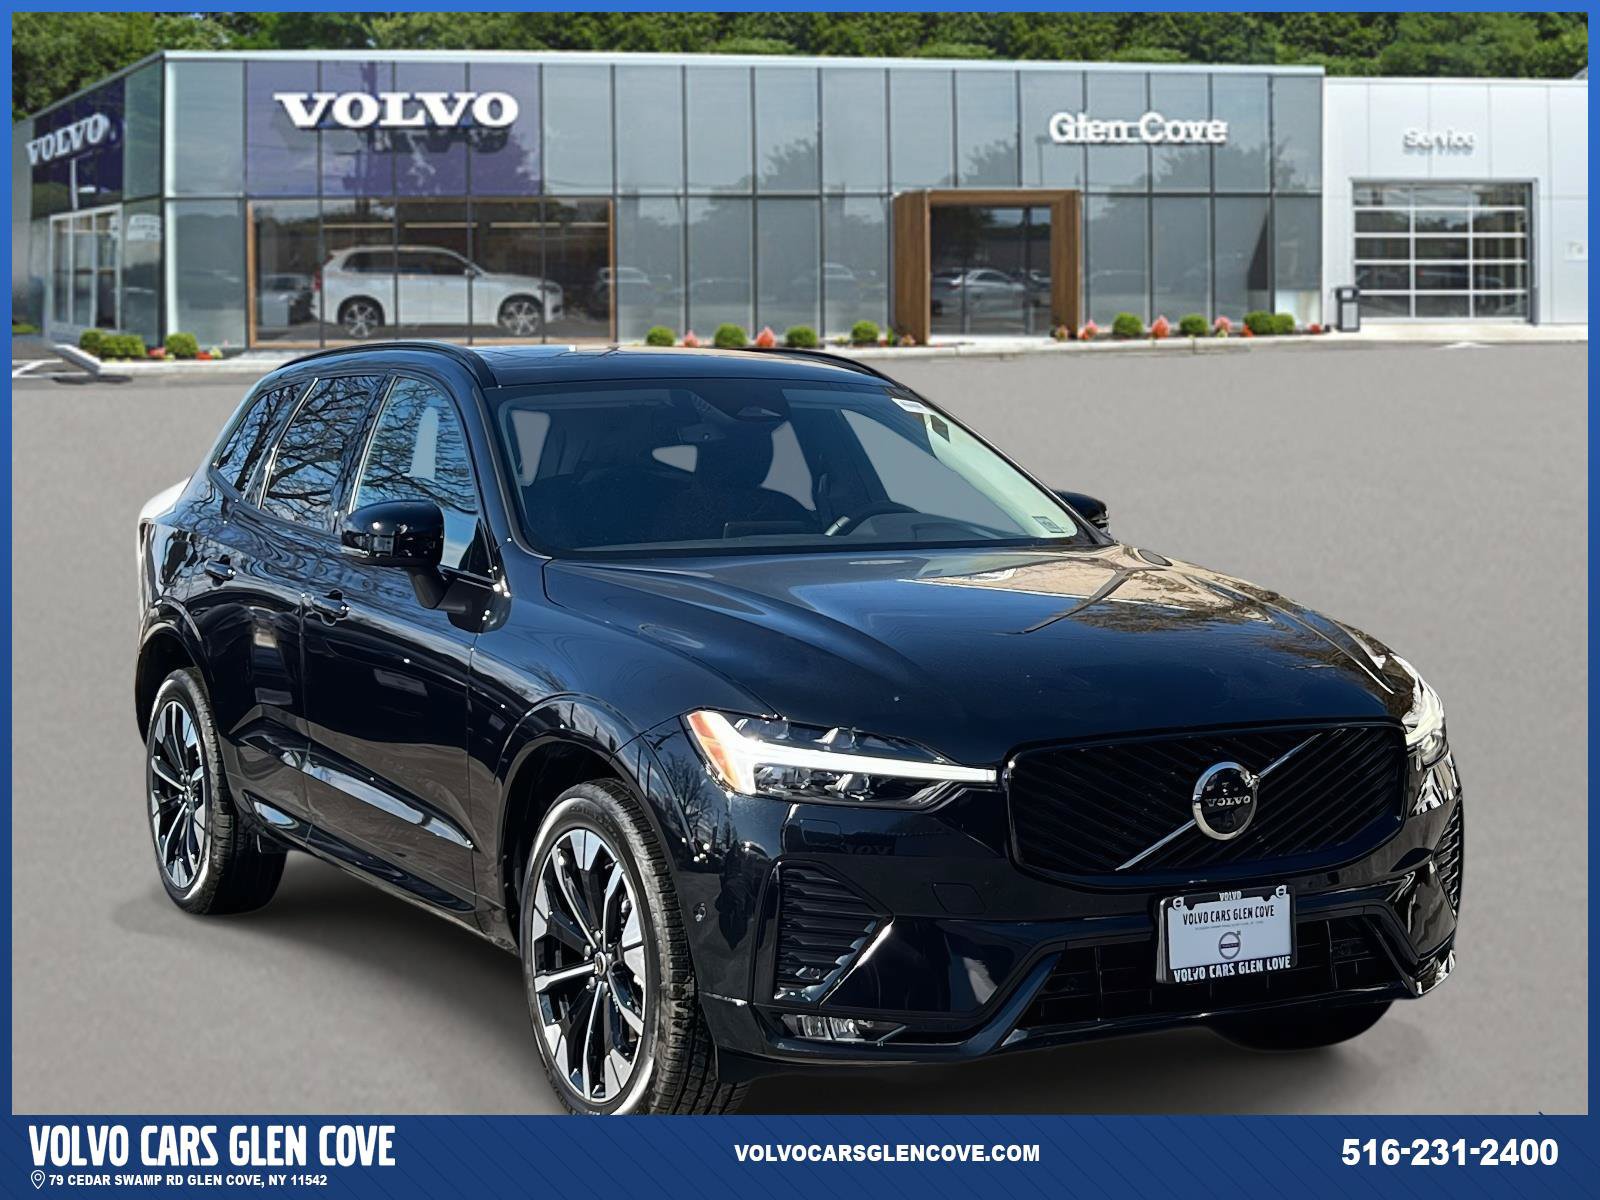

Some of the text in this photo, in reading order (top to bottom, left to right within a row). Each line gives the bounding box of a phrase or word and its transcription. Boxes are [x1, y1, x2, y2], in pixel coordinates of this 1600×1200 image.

[273, 91, 519, 128] VOLVO
[1049, 111, 1229, 143] Glen Cove
[25, 112, 111, 166] VOLVO
[1205, 795, 1251, 807] VOLVO
[1219, 891, 1242, 901] VOLVO
[1183, 912, 1208, 925] VOLVO
[1211, 909, 1231, 922] CARS
[1233, 907, 1253, 920] GLEN
[1255, 905, 1274, 918] COVE
[1173, 967, 1206, 983] VOLVO
[1209, 963, 1235, 978] CARS
[1238, 960, 1263, 974] GLEN
